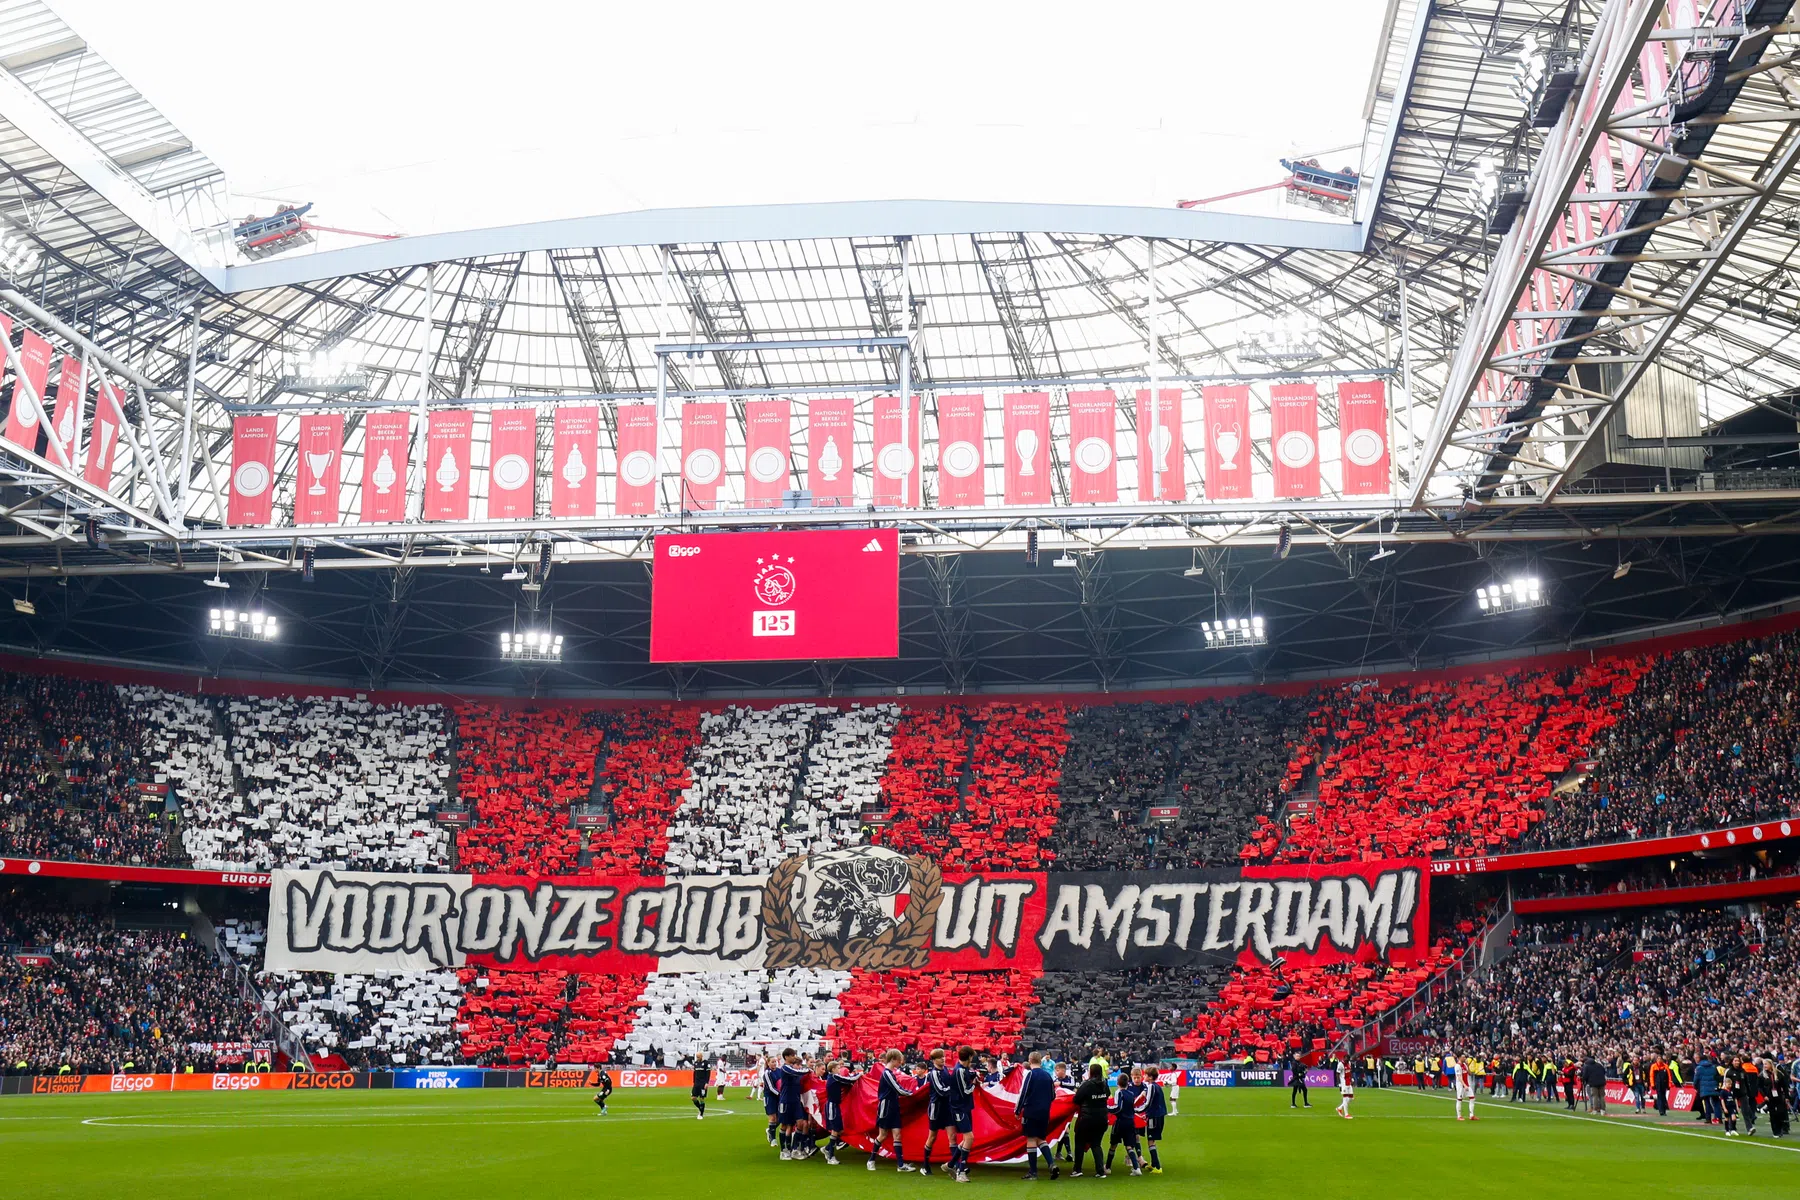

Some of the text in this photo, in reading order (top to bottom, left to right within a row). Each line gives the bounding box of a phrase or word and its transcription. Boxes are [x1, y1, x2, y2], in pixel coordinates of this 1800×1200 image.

[754, 564, 774, 584] AJAX
[758, 616, 789, 631] 125
[222, 874, 272, 884] EUROPA
[287, 868, 1420, 964] VOOR ONZE CLUB UIT AMSTERDAM!
[765, 937, 929, 970] 125 Jaar
[53, 1075, 81, 1083] ZIGGO
[550, 1070, 584, 1078] ZIGGO
[1241, 1072, 1278, 1080] UNIBET
[416, 1078, 460, 1088] max
[550, 1079, 583, 1088] SPORT
[52, 1084, 80, 1093] SPORT
